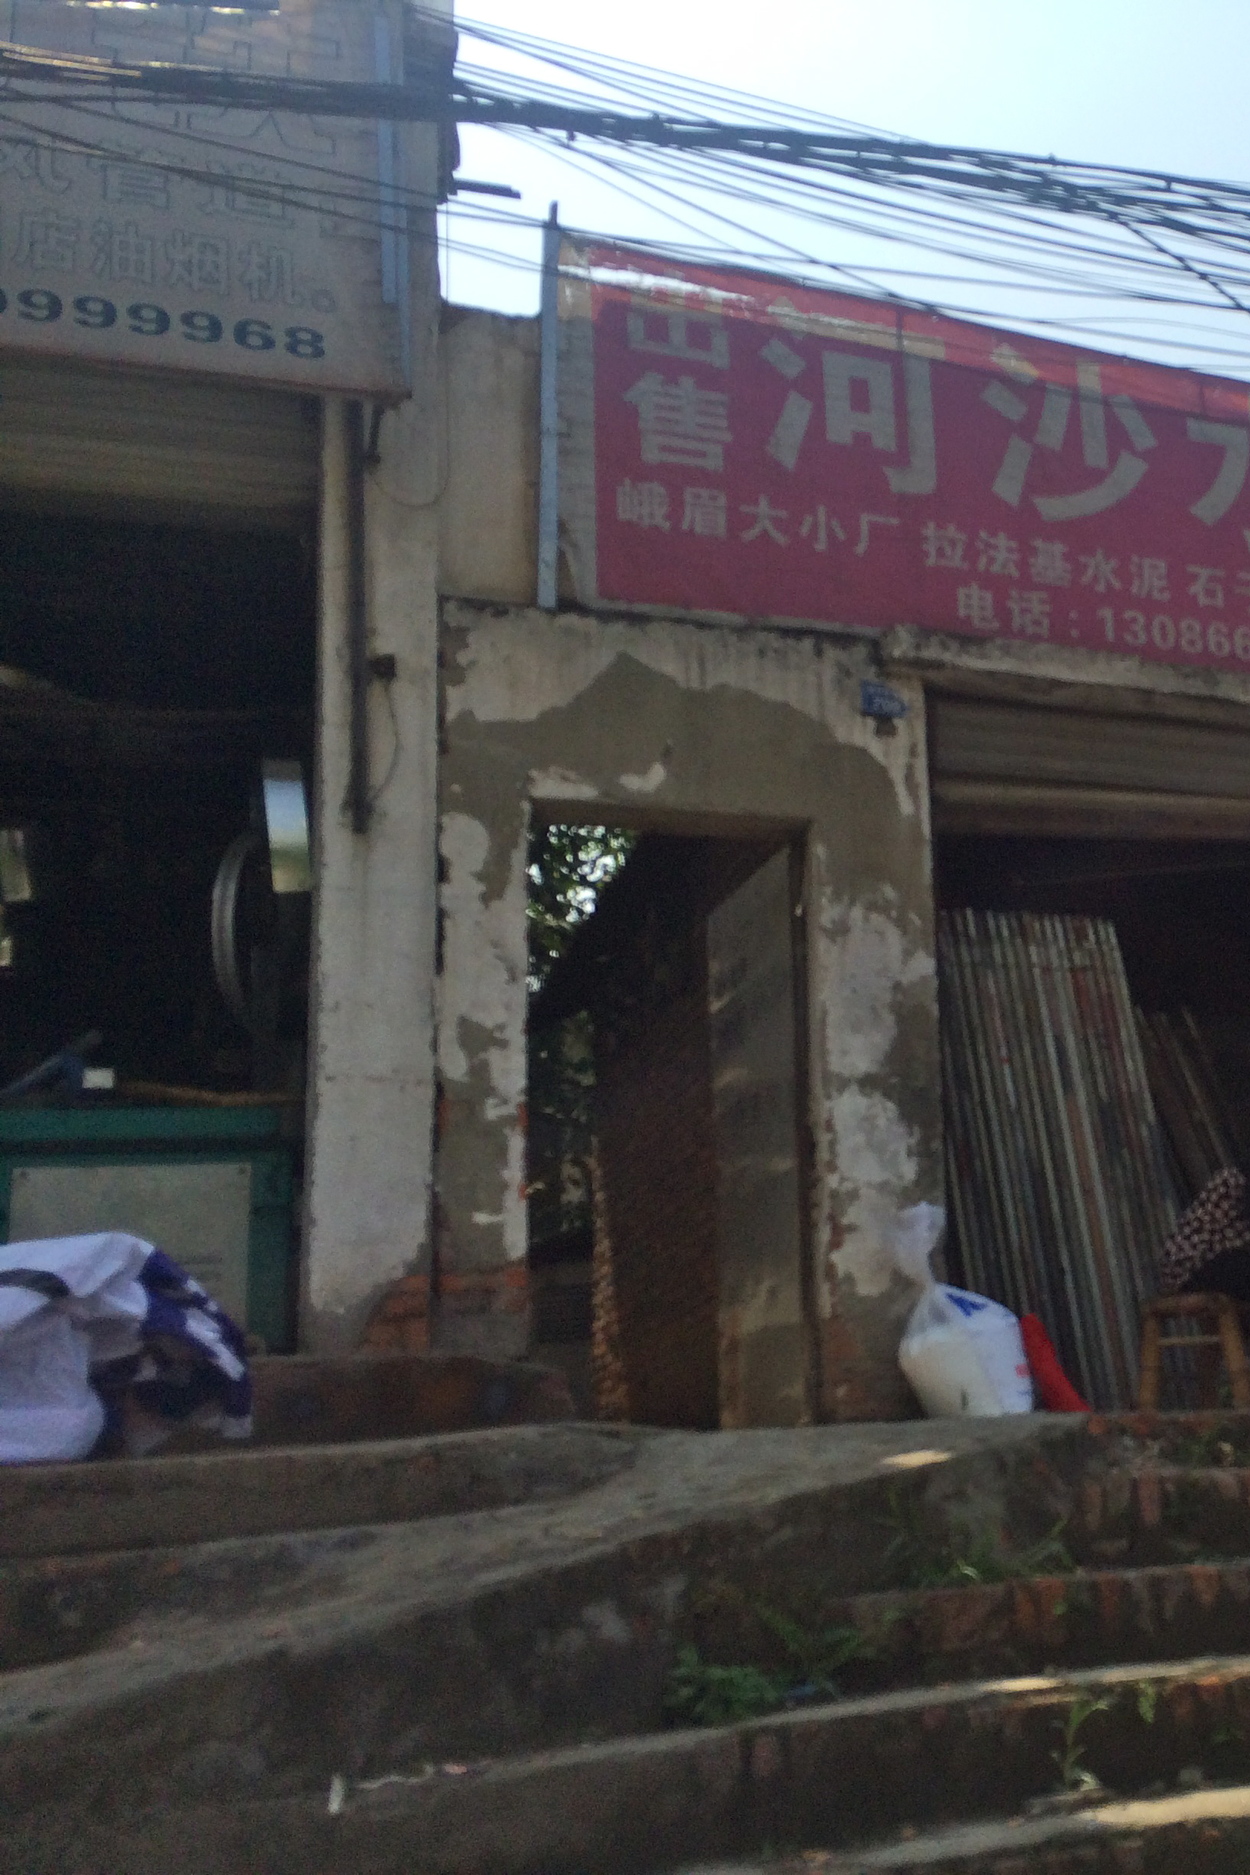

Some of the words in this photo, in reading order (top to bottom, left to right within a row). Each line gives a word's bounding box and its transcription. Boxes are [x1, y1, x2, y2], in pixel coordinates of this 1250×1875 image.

[0, 287, 326, 360] 999968
[615, 477, 900, 557] 峨眉大小厂
[920, 520, 1170, 603] 拉法基水泥
